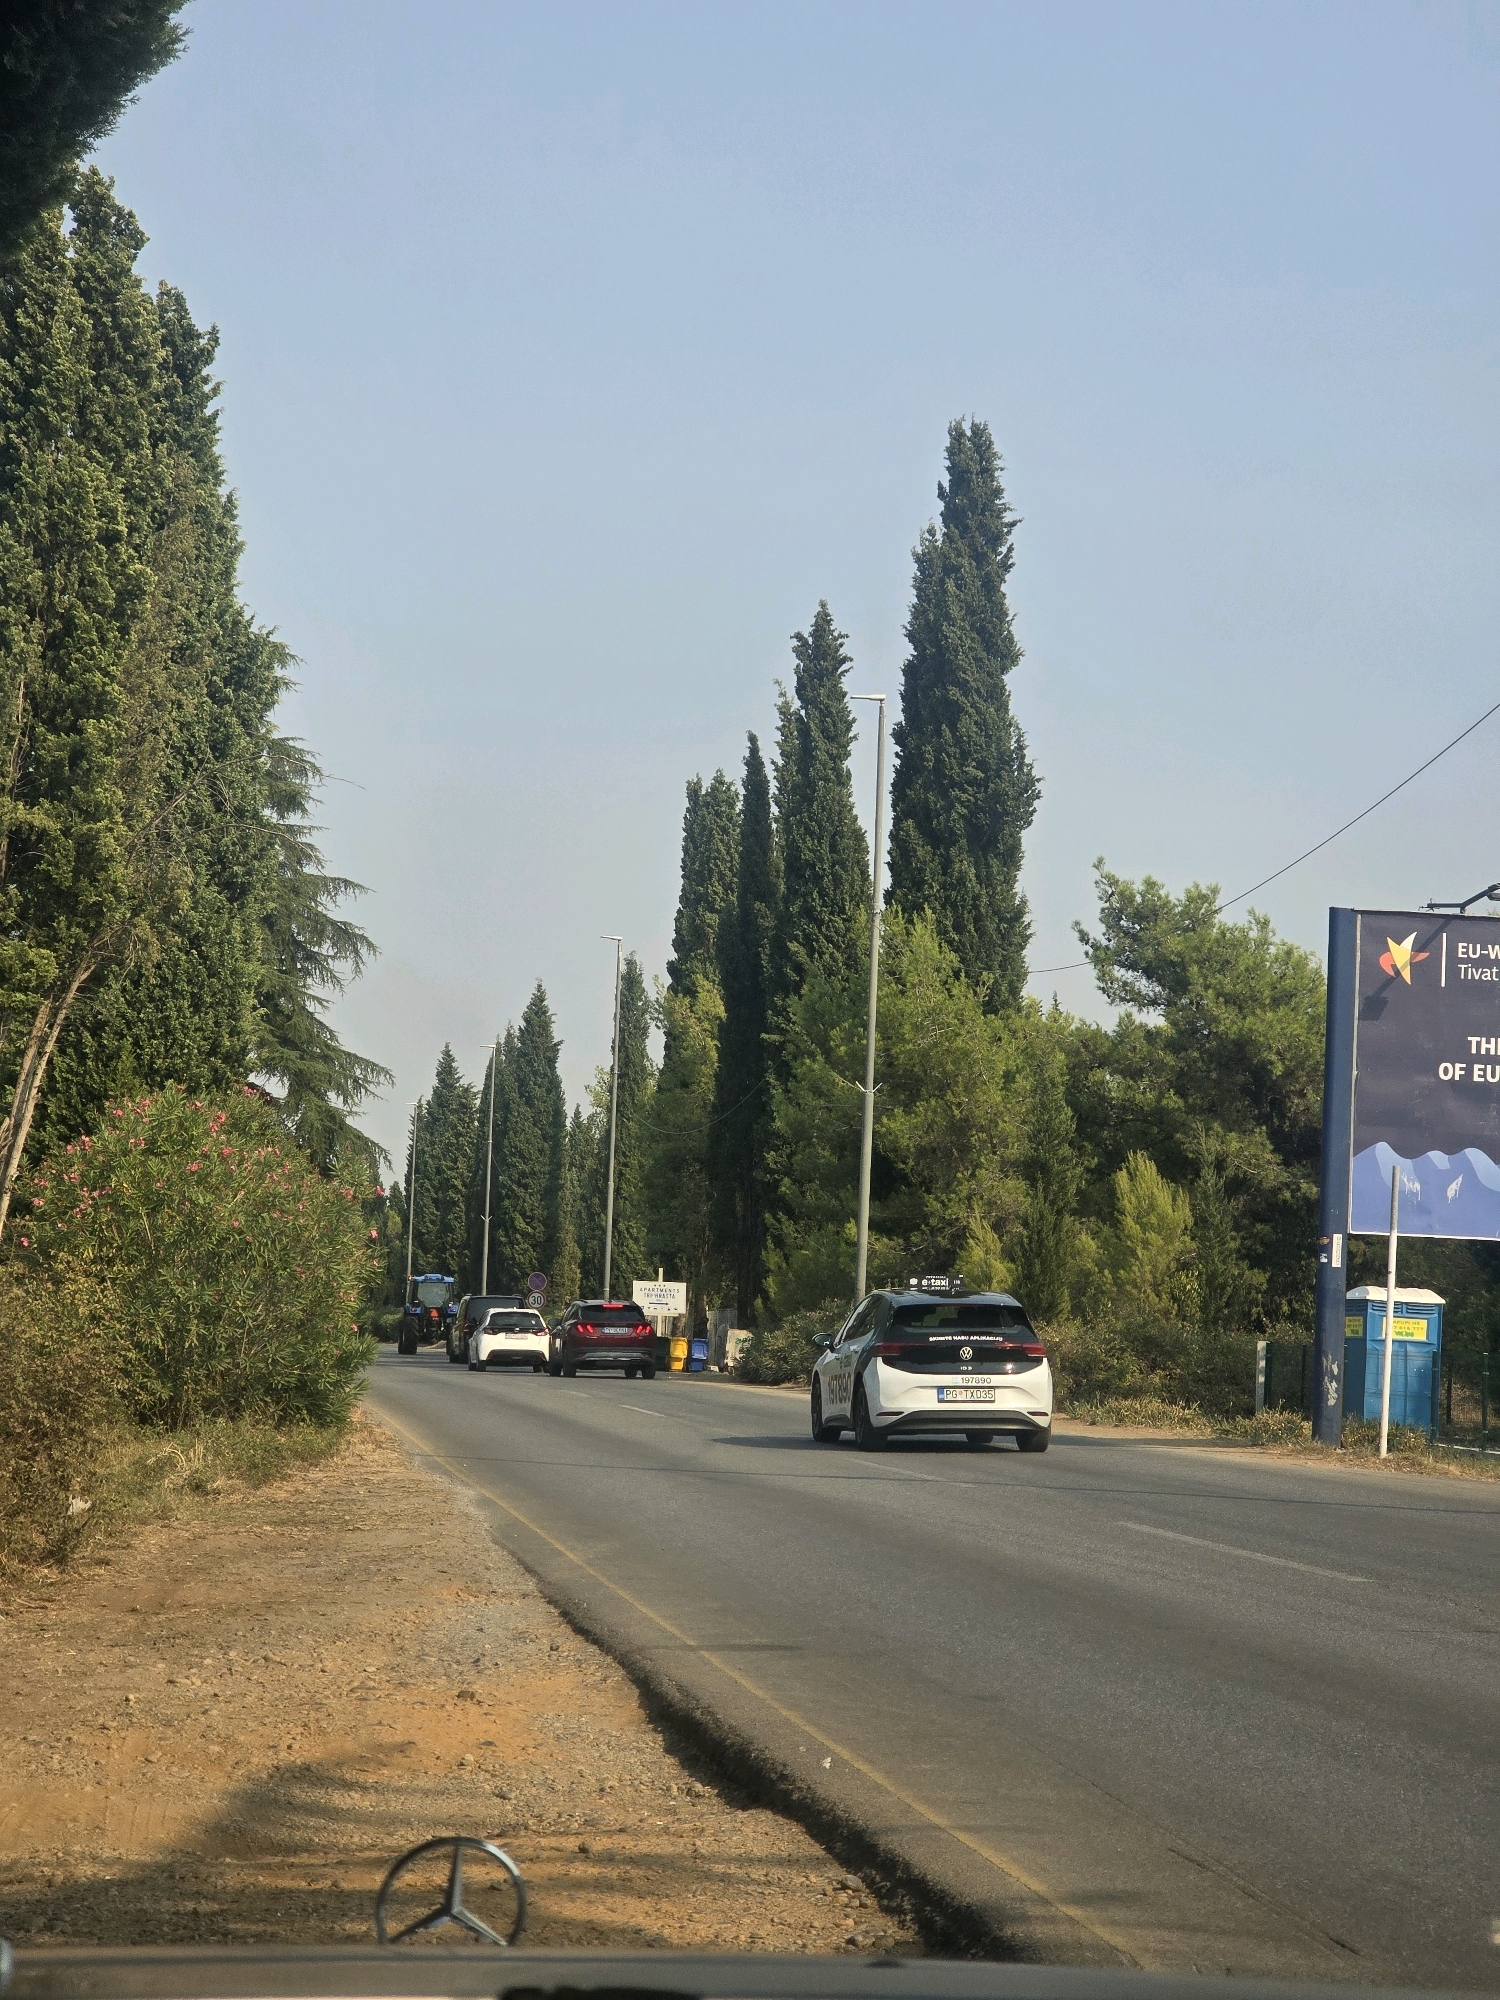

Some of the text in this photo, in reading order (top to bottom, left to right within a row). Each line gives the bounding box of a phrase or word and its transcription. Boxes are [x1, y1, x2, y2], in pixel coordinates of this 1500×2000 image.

[1457, 963, 1500, 981] Tivat
[1467, 1036, 1500, 1056] TH
[1438, 1062, 1467, 1081] OF
[530, 1295, 542, 1305] 30
[945, 1390, 958, 1400] PG
